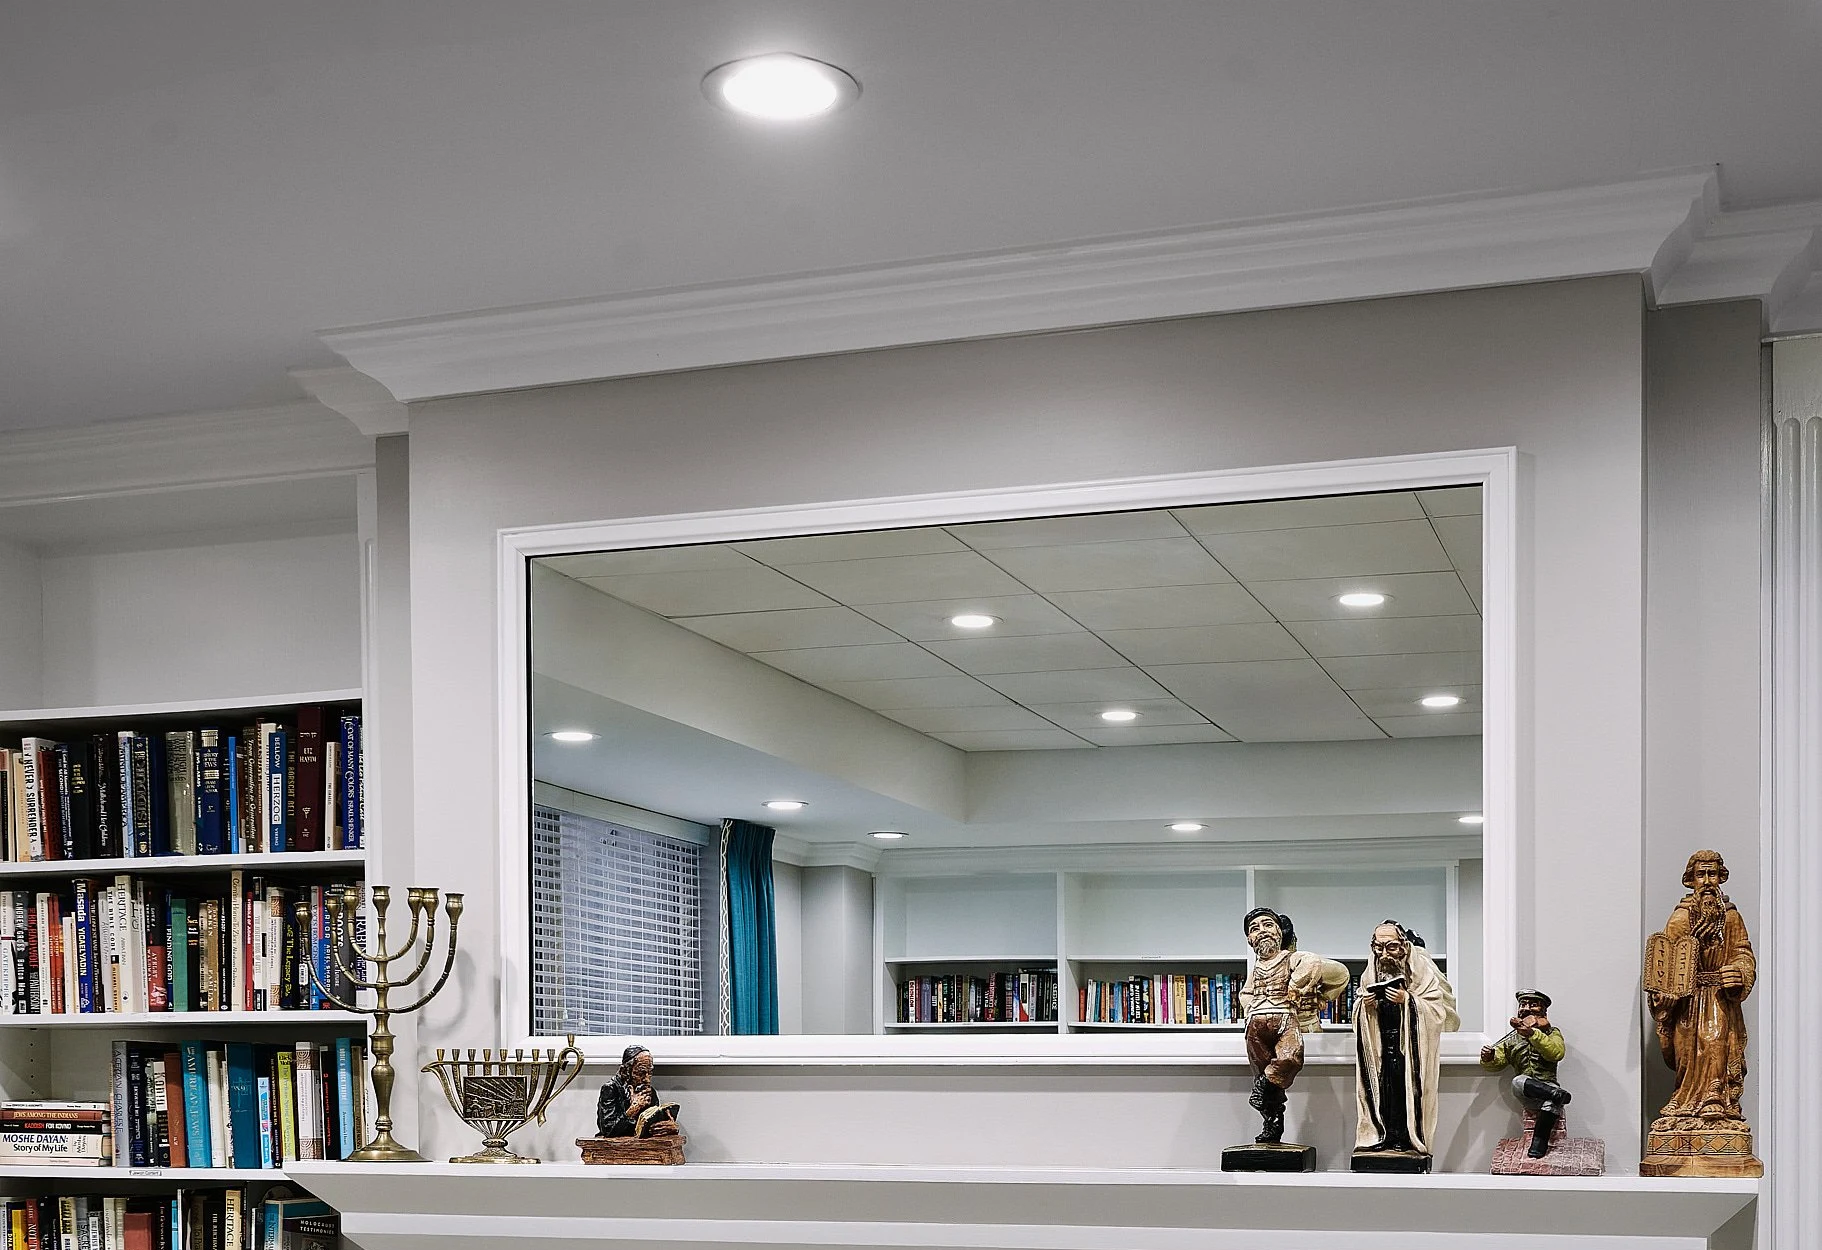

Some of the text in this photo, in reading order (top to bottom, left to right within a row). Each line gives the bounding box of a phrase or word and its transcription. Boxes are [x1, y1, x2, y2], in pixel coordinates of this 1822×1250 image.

[344, 722, 354, 740] COAT
[348, 741, 354, 750] OF
[345, 771, 354, 798] COLORS
[24, 760, 37, 837] NEVER SURRENDER
[76, 883, 86, 922] Masada
[117, 883, 127, 931] HERITAGE
[16, 903, 24, 928] ANDREW
[233, 922, 239, 930] To
[17, 931, 25, 952] GROSS
[30, 947, 38, 968] WOLF
[285, 955, 294, 982] Legacy
[18, 983, 26, 996] Man
[30, 979, 39, 1010] PATTERSON
[115, 1058, 123, 1089] CERTAIN
[187, 1055, 200, 1137] AMERICAN JEWS
[3, 1135, 68, 1143] MOSHE DAYAN:
[14, 1144, 32, 1153] Story
[34, 1144, 41, 1152] of
[42, 1145, 54, 1154] My
[194, 1227, 202, 1236] To
[226, 1198, 234, 1247] HERITAGE
[300, 1220, 335, 1228] HOLOCAUST
[300, 1226, 335, 1235] TESTIMONIES
[28, 1224, 37, 1243] NOT
